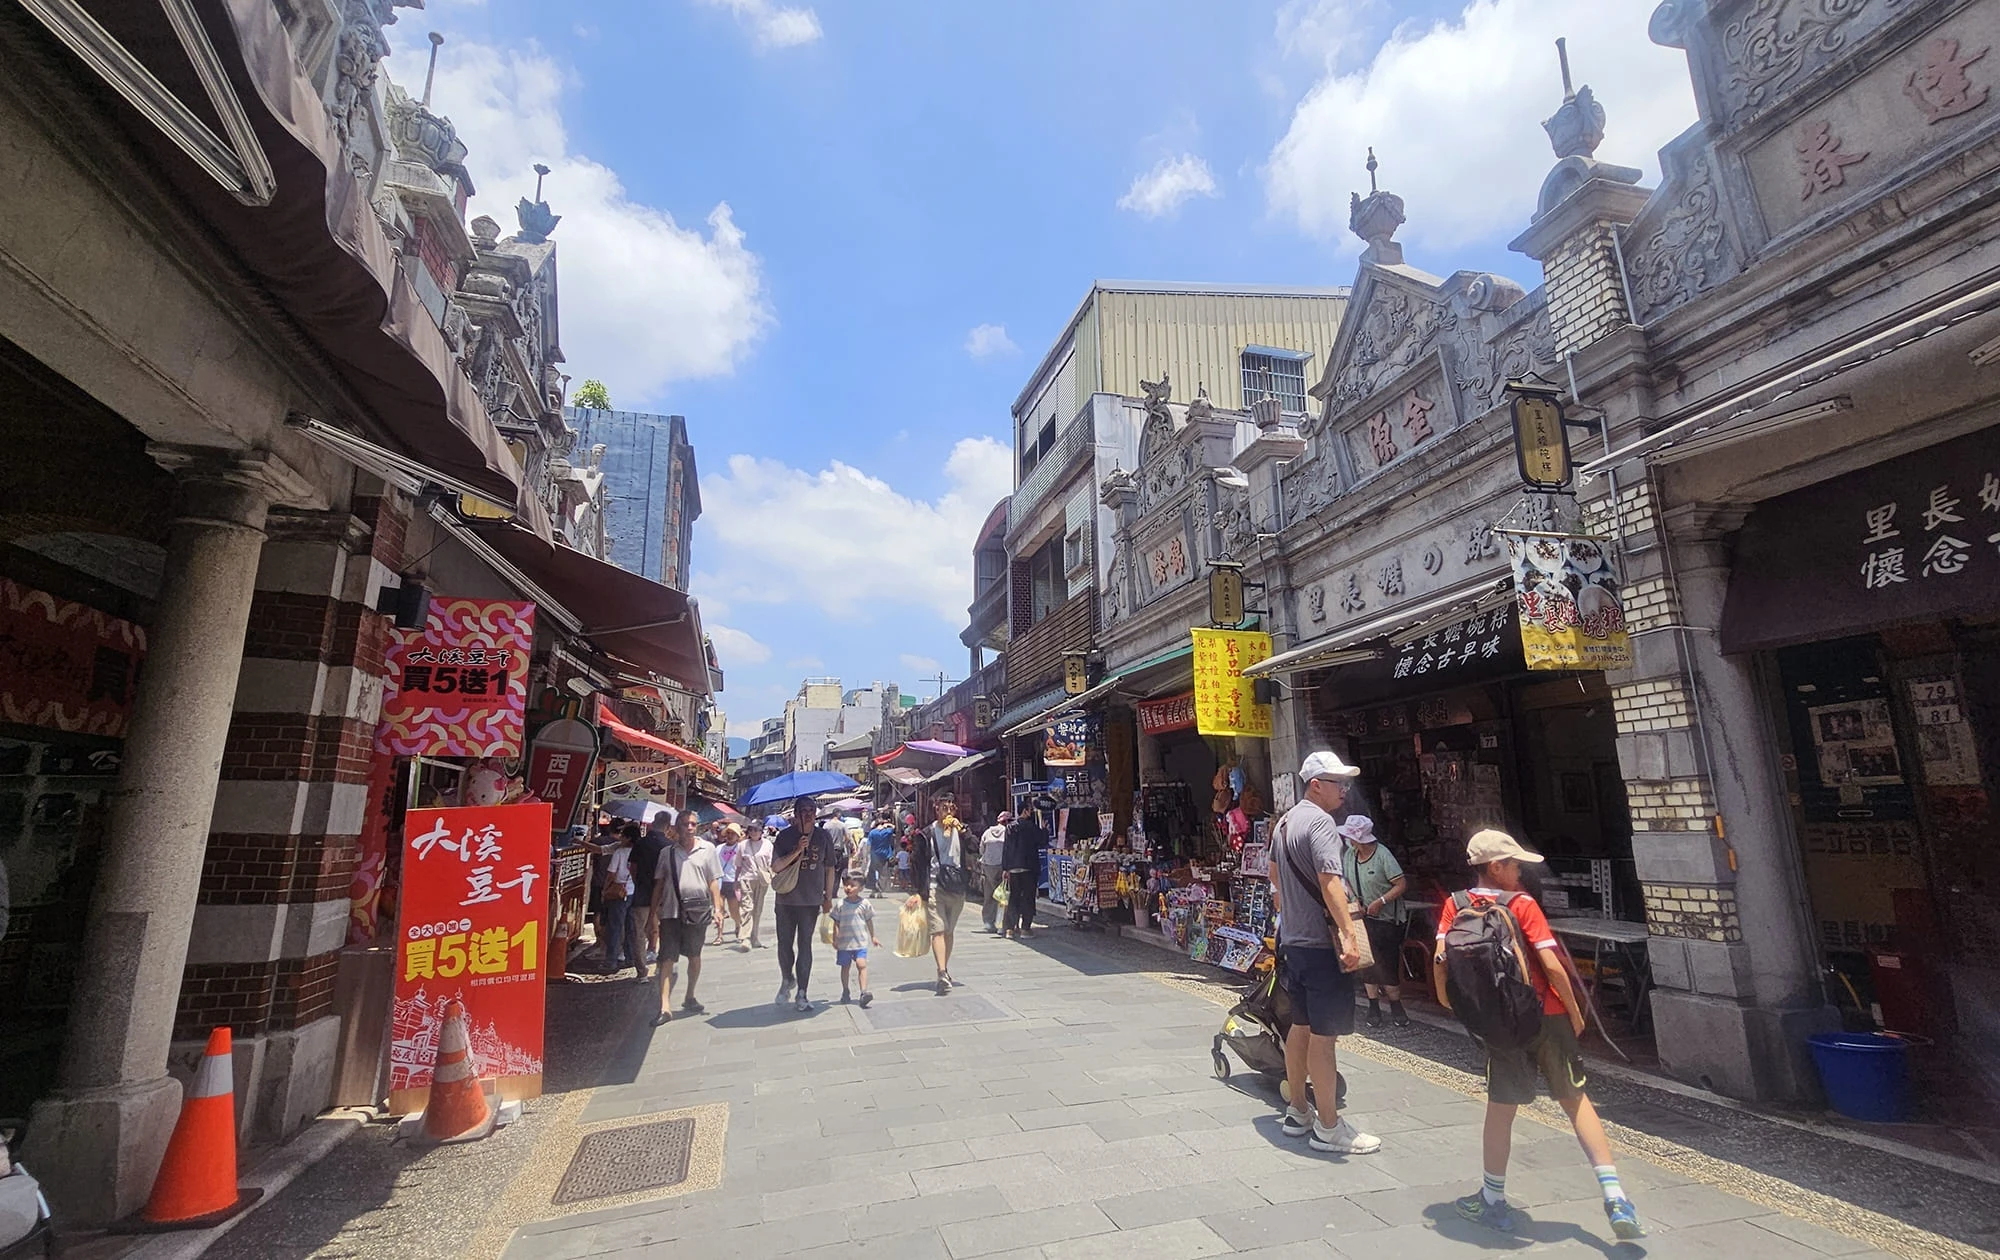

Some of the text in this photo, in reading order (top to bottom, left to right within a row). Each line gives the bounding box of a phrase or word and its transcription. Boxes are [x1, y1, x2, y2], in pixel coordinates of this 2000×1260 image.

[1860, 532, 2000, 589] 懷念
[1522, 590, 1625, 639] 里長嬤碗粿
[407, 646, 511, 667] 大溪豆干
[1393, 635, 1502, 679] 懷念古早味
[402, 665, 509, 696] 買5送1
[1925, 685, 1946, 699] 79
[542, 753, 571, 799] 西瓜
[411, 817, 502, 862] 大溪
[459, 864, 540, 906] 豆干
[409, 918, 471, 939] 全大溪唯一
[404, 920, 538, 982] 買5送1
